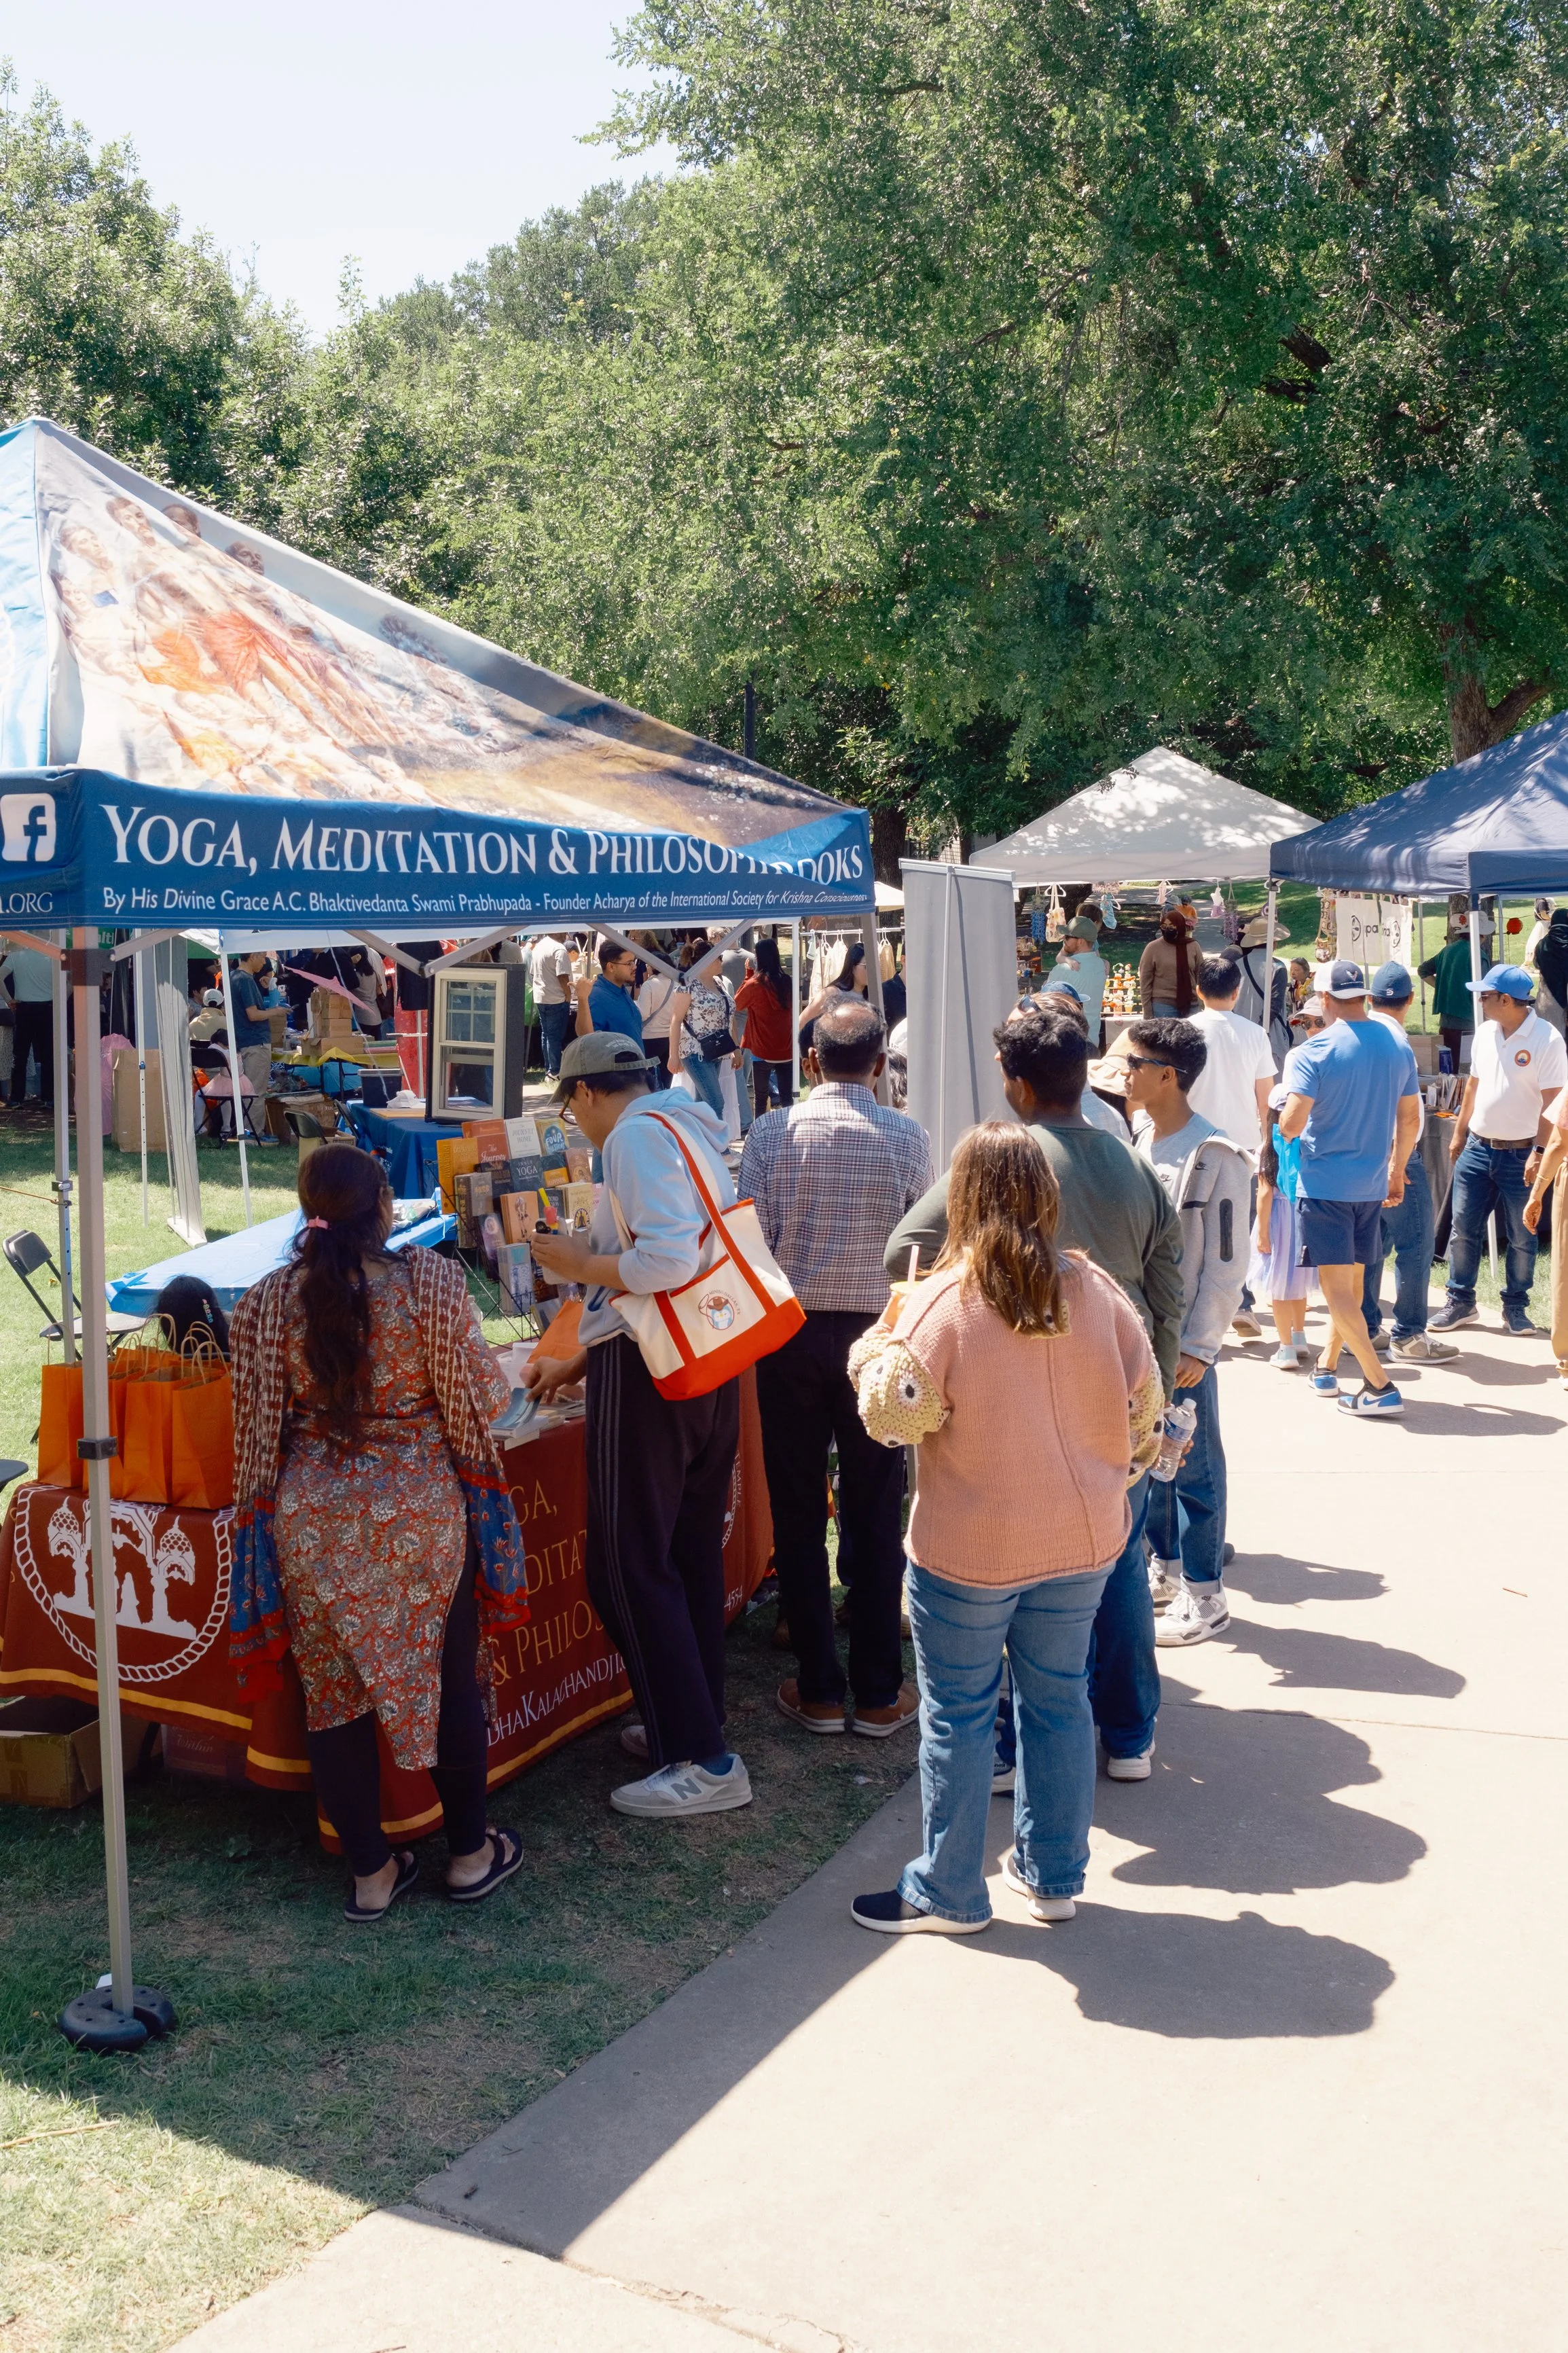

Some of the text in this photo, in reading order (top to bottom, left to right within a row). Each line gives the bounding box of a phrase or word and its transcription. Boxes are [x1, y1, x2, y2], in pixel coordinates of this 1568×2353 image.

[98, 804, 257, 876] YOGA,
[270, 816, 536, 875] MEDITATION
[549, 827, 579, 875] &
[104, 887, 126, 914] By
[132, 888, 158, 908] His
[164, 888, 215, 910] Divine
[221, 890, 269, 910] Grace
[273, 891, 306, 912] A.C.
[310, 892, 409, 912] Bhaktivedanta
[412, 893, 456, 912] Swami
[458, 893, 532, 916] Prabhupada
[544, 893, 591, 910] Founder
[595, 891, 635, 913] Acharya
[638, 892, 652, 908] of
[652, 891, 668, 908] the
[671, 890, 730, 907] International
[731, 890, 764, 909] Society
[765, 890, 780, 905] for
[780, 891, 814, 904] Krishna
[545, 1132, 563, 1147] FOUR
[488, 1144, 498, 1152] The
[481, 1153, 506, 1163] Journey
[516, 1165, 538, 1177] YOGA
[514, 1600, 604, 1674] PHILO
